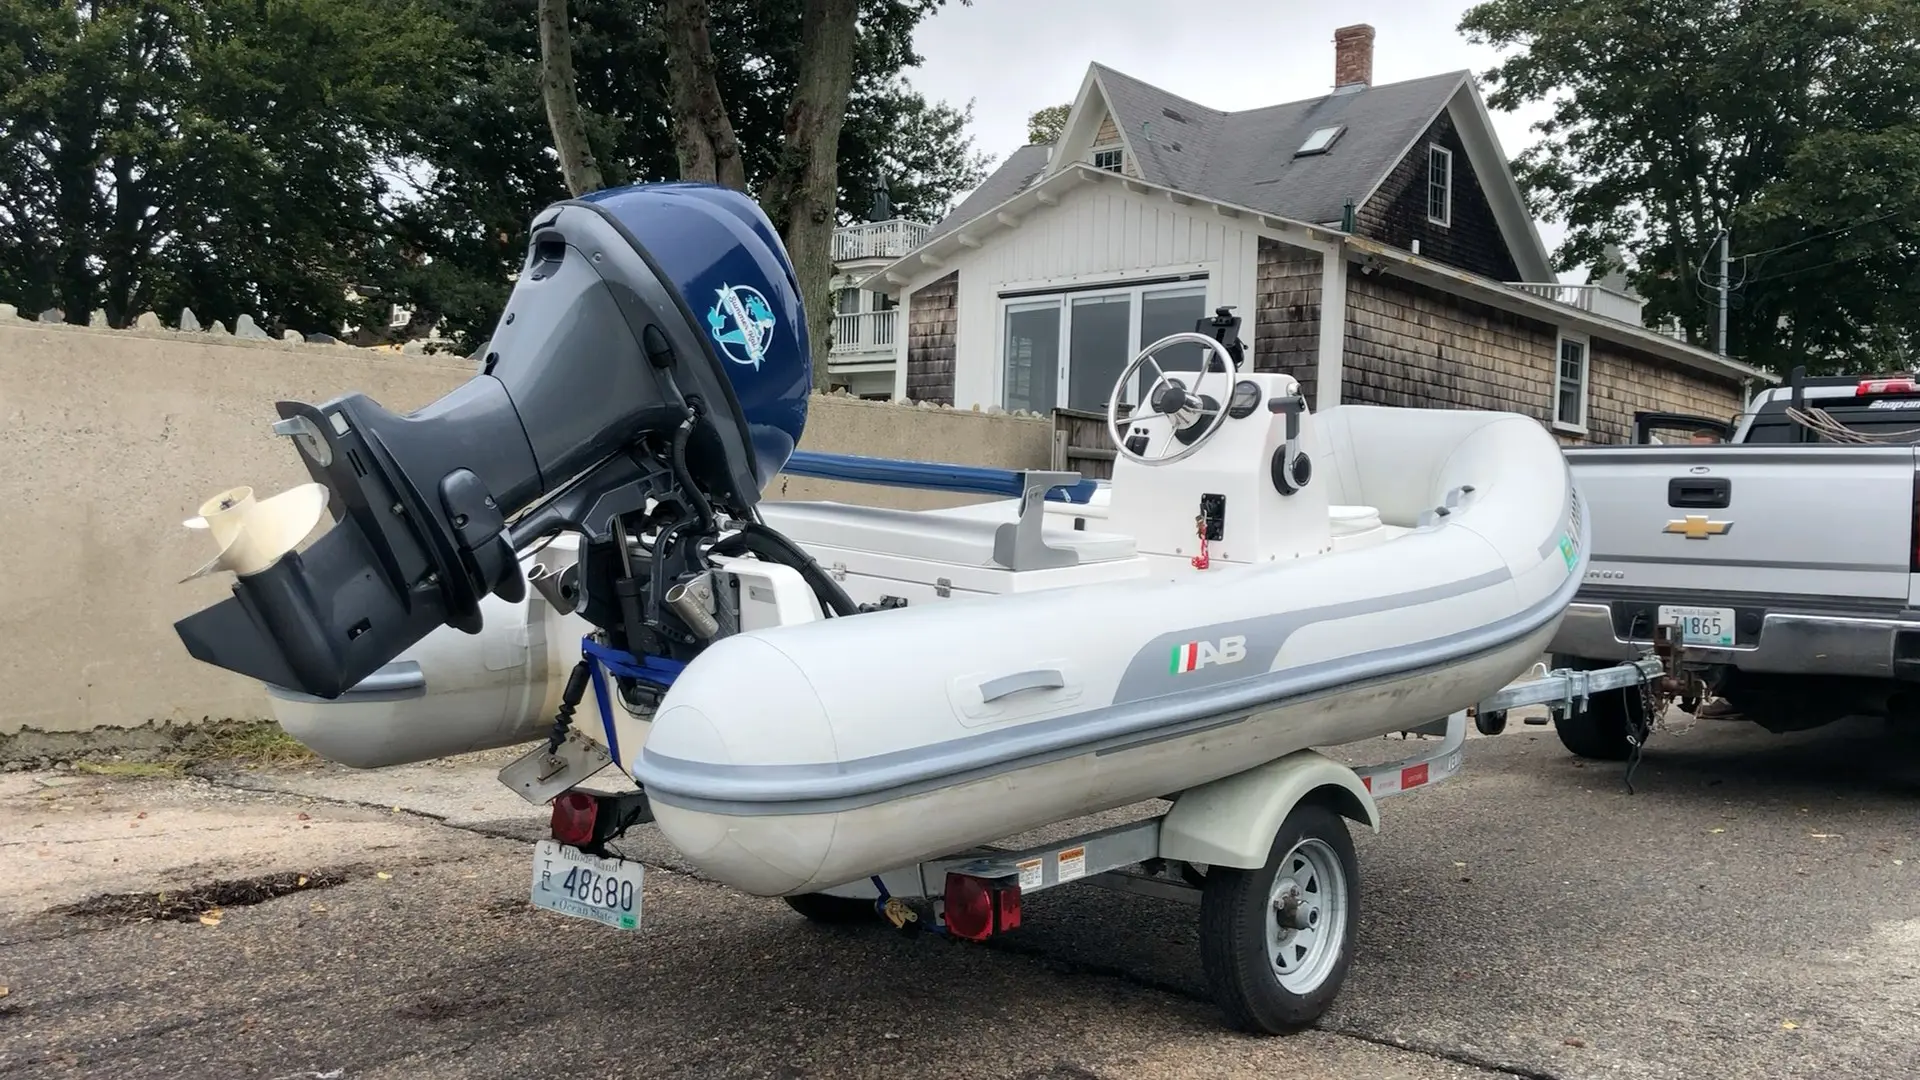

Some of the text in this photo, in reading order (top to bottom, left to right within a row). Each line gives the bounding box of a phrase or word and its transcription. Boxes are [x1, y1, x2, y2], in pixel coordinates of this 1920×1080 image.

[1194, 635, 1247, 670] AB
[563, 866, 633, 912] 48680
[559, 900, 614, 921] Ocean State
